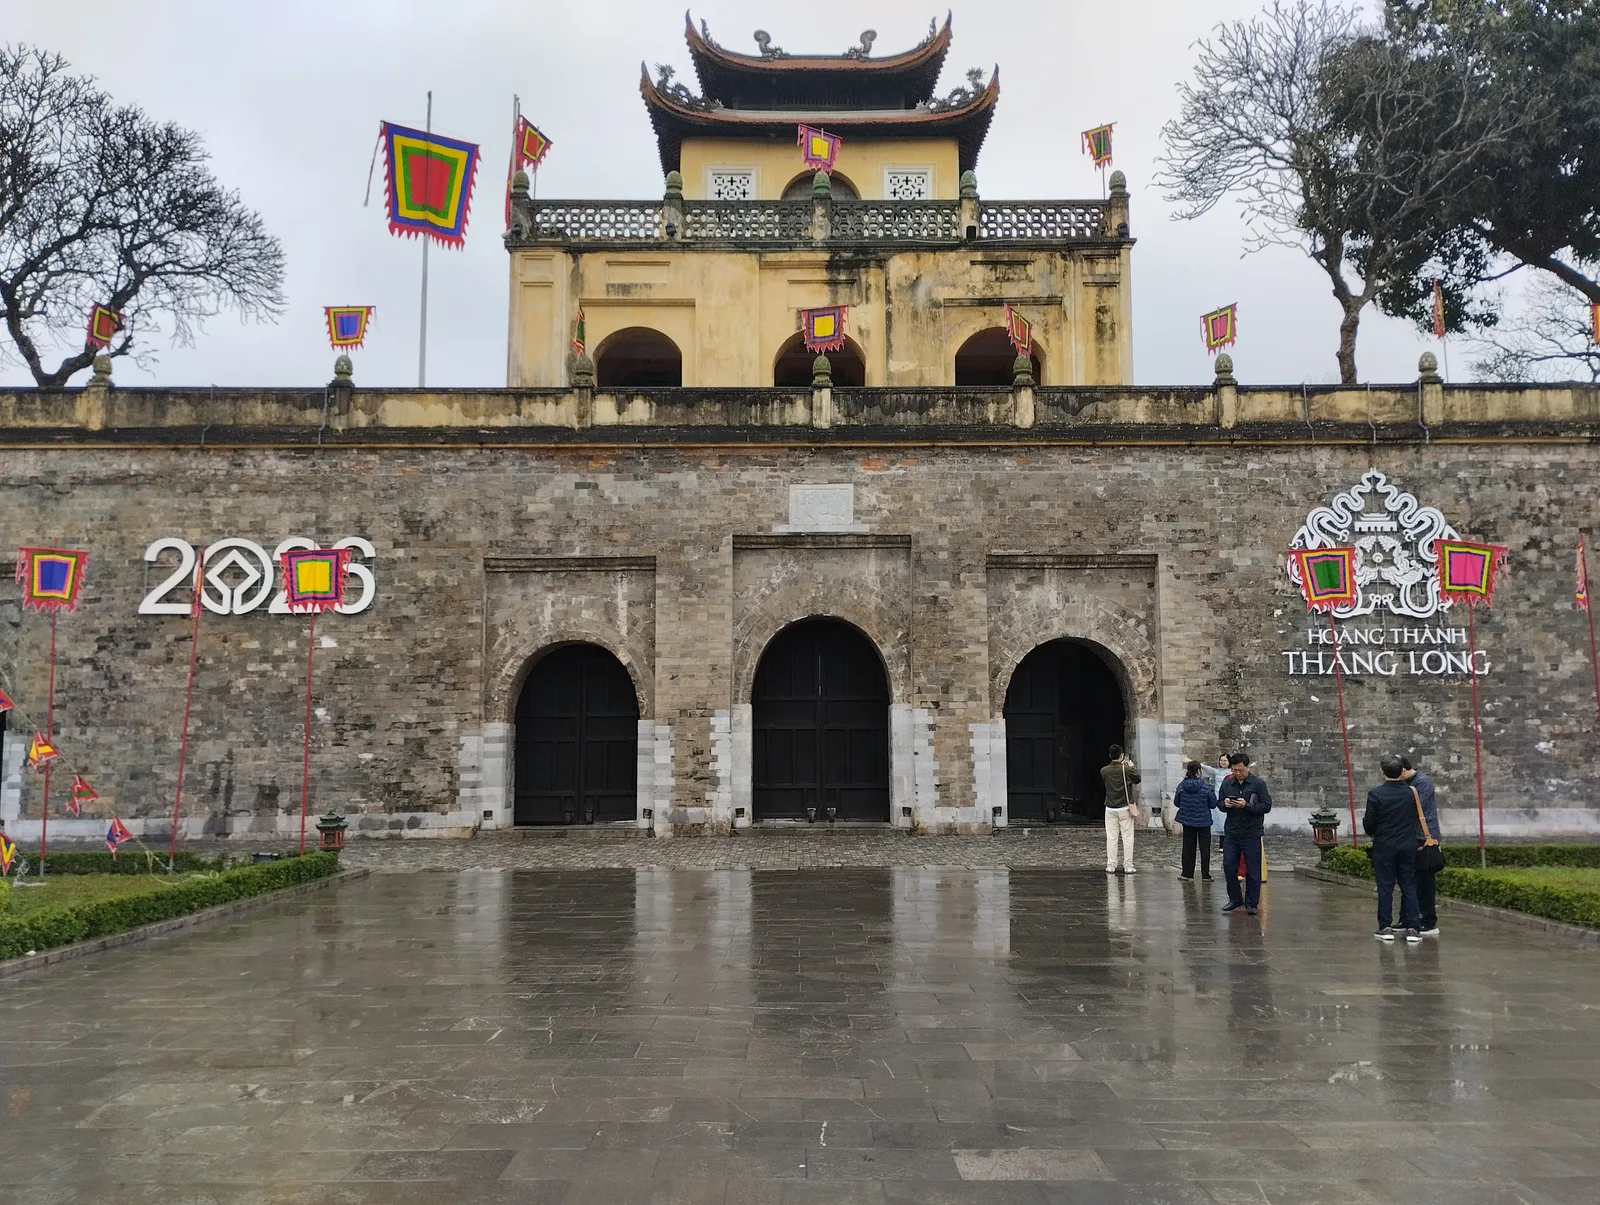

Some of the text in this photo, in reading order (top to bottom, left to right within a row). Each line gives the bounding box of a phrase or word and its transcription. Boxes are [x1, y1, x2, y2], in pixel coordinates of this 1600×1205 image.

[1308, 624, 1467, 645] HOÀNG THÀNH
[1410, 650, 1492, 675] LONG
